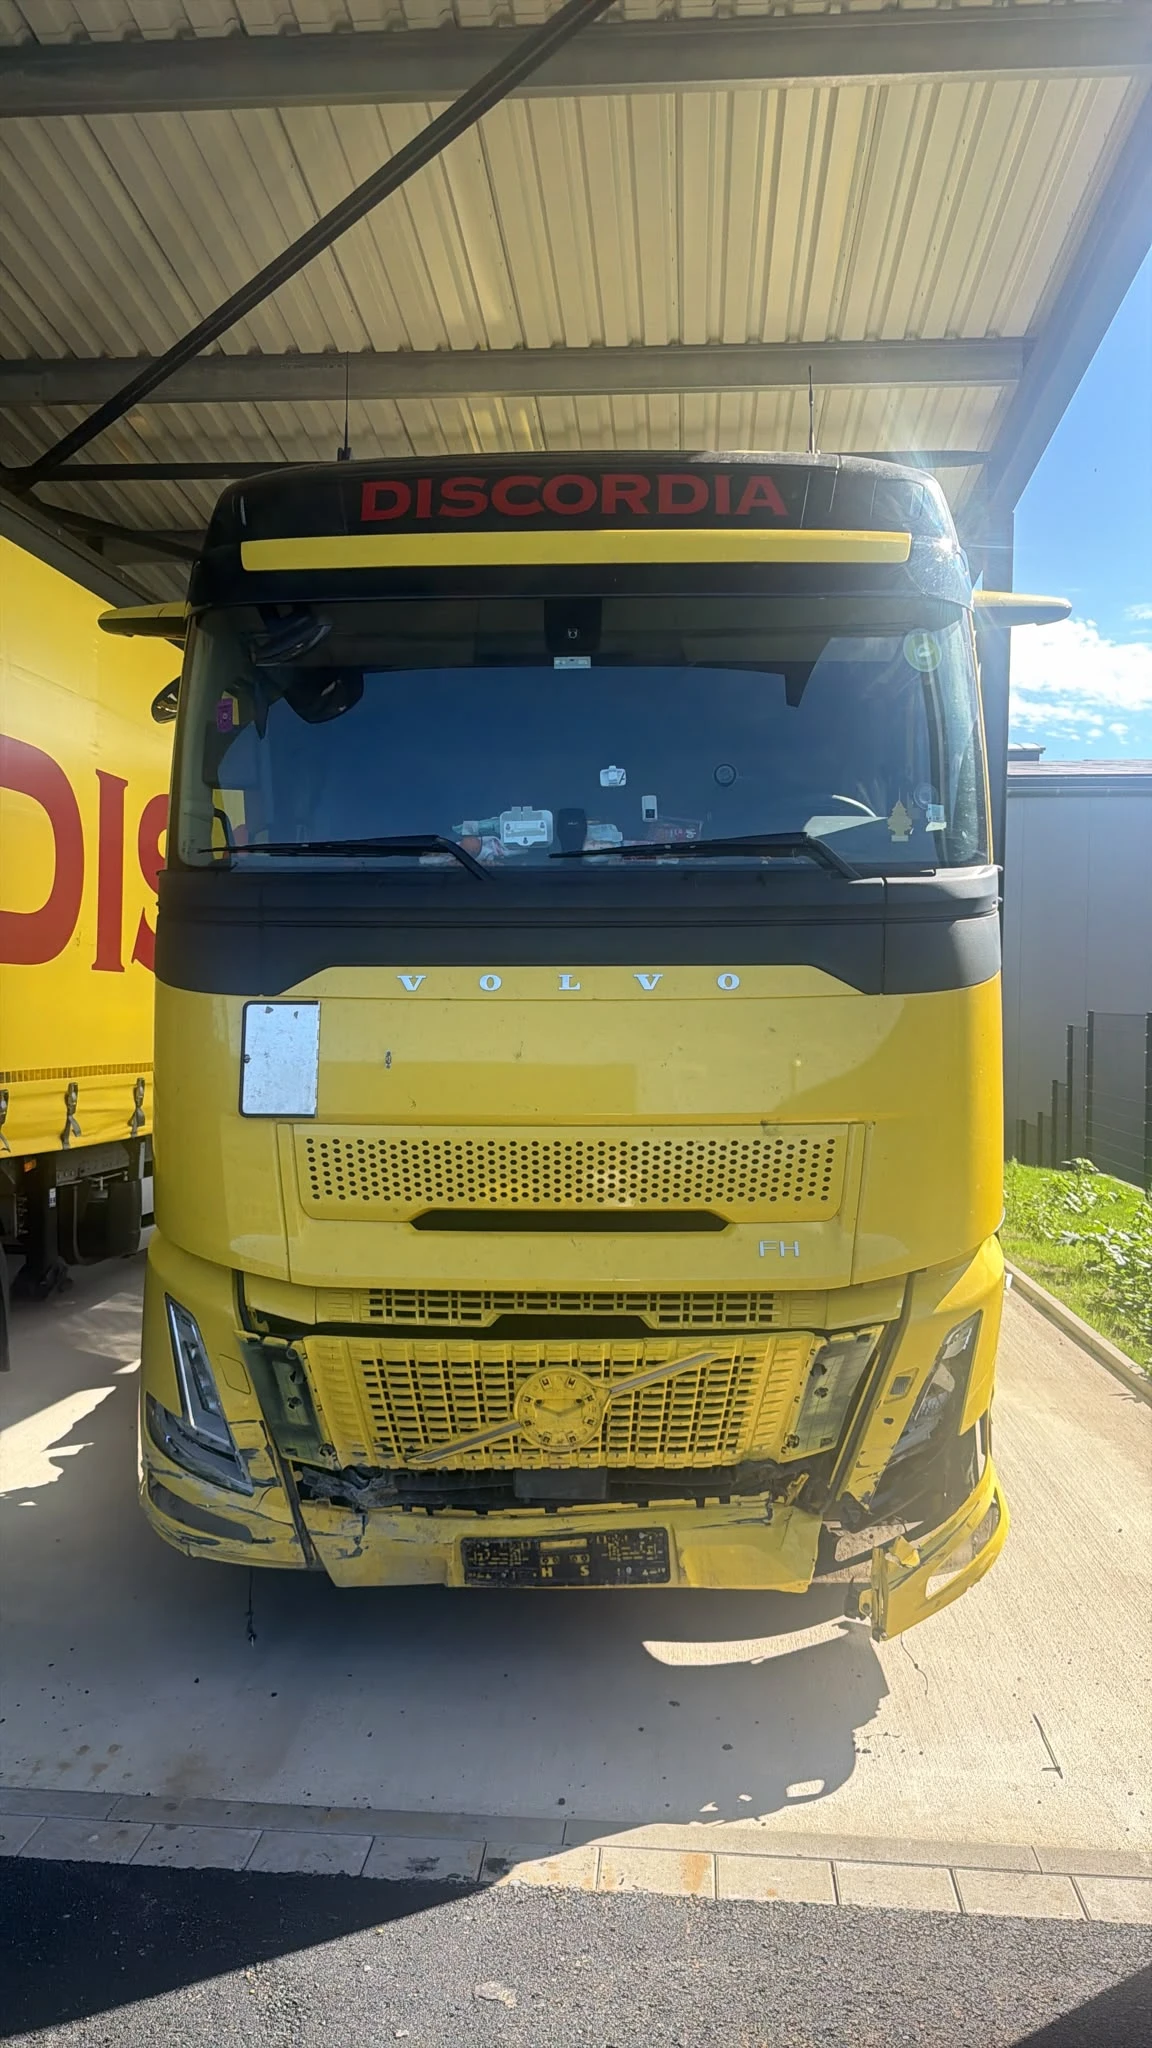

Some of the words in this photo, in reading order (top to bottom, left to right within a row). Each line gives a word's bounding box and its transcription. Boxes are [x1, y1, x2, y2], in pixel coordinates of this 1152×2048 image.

[360, 473, 789, 522] DISCORDIA
[396, 972, 741, 992] VOLVO
[759, 1239, 800, 1257] FH
